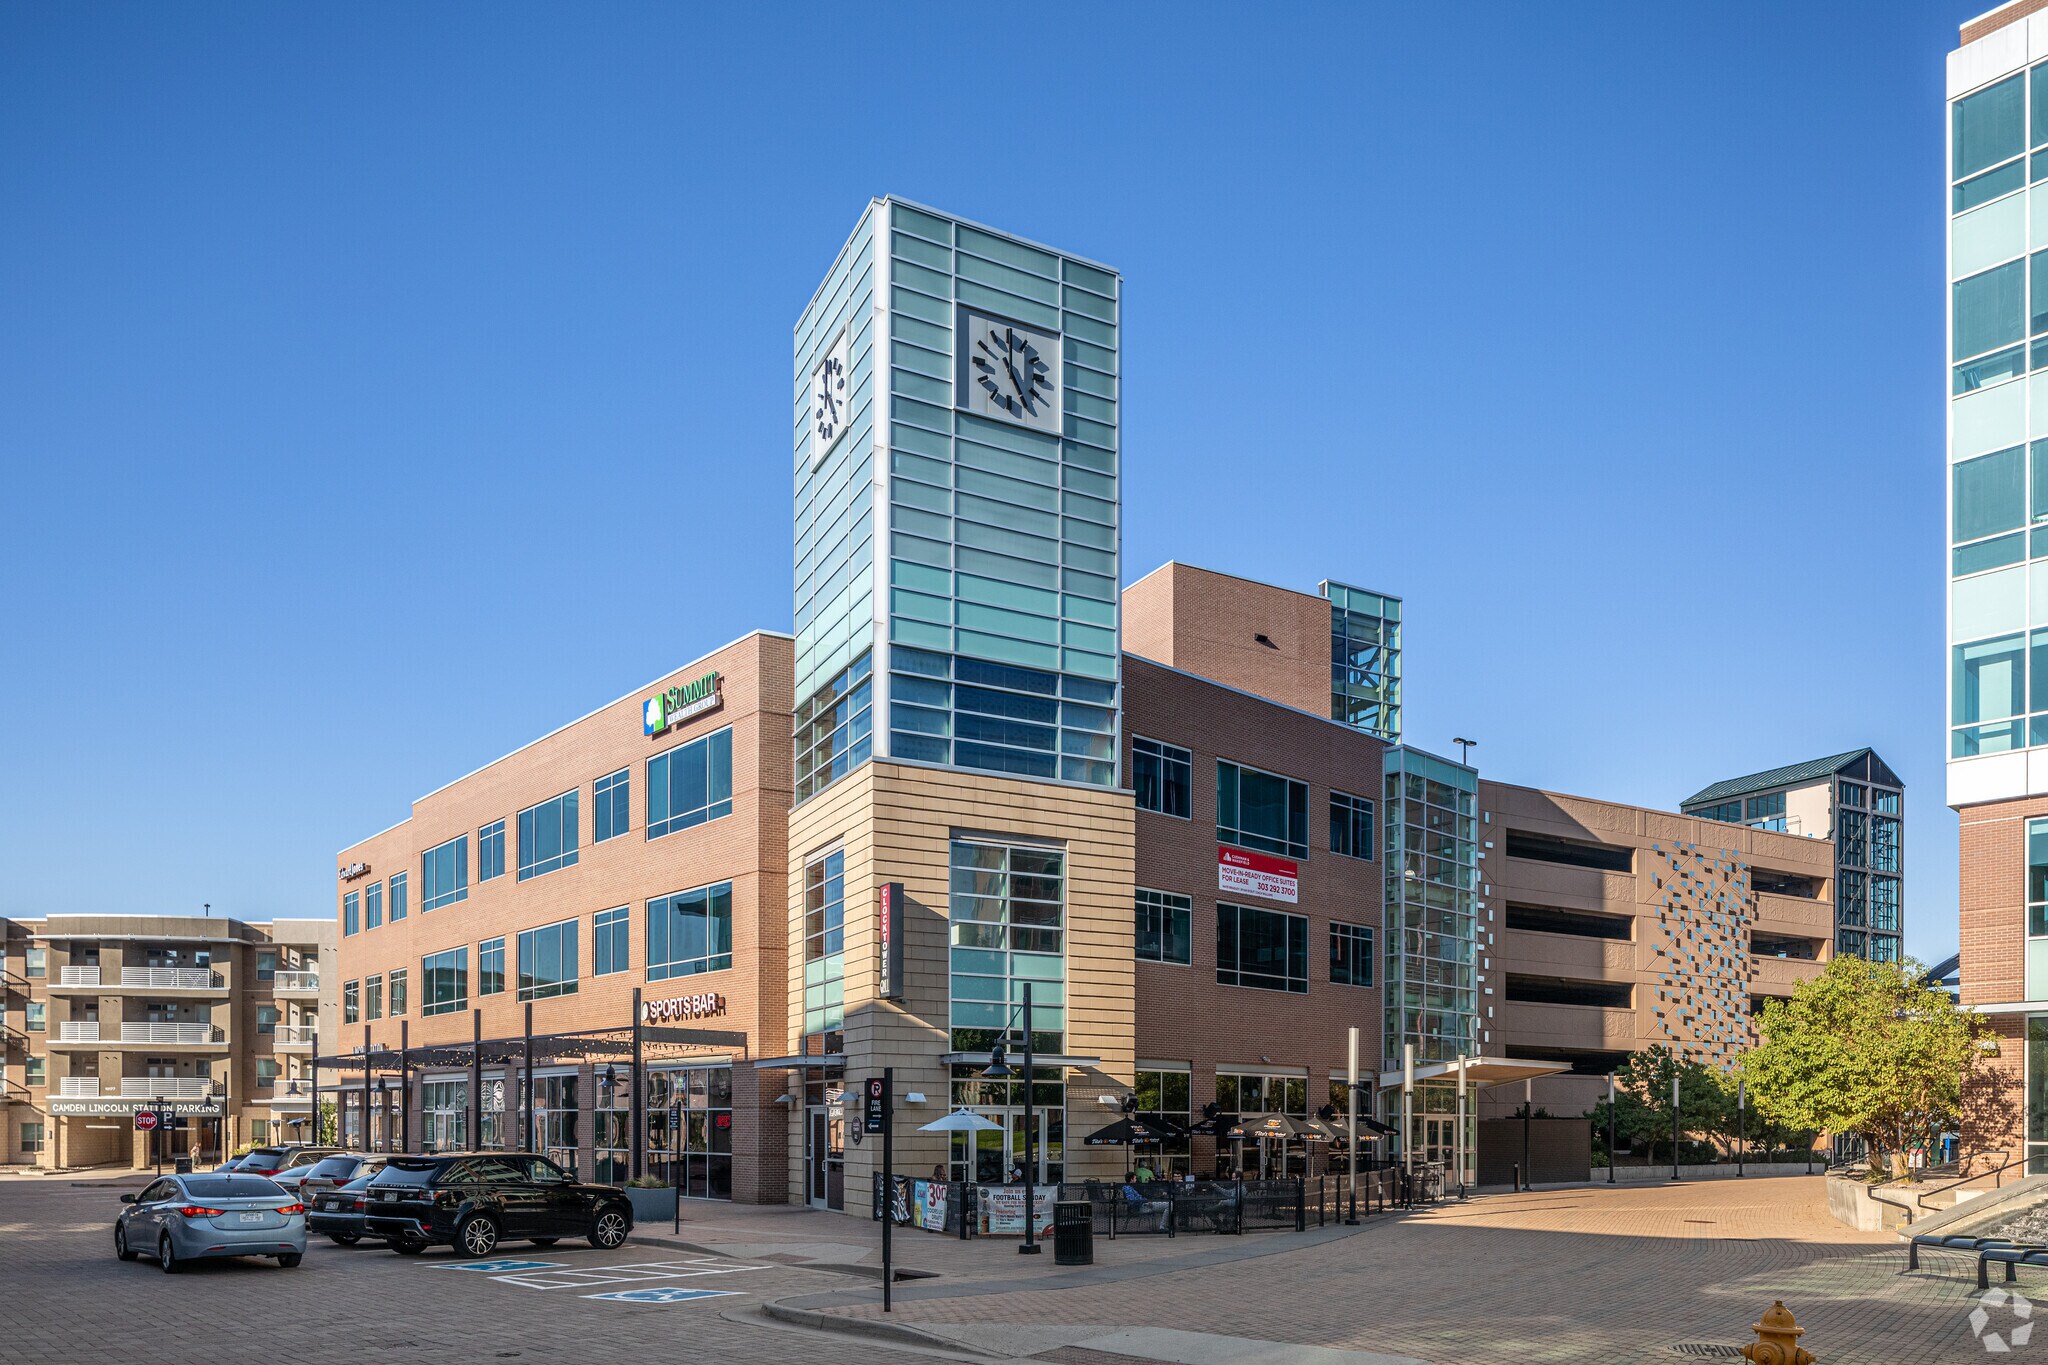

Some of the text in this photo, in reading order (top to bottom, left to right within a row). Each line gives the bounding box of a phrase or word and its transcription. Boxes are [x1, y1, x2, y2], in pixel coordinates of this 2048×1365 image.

[667, 671, 716, 713] SUMMIT
[1221, 866, 1296, 887] MOVE-IN-READY OFFICE SUITES
[1221, 874, 1249, 886] FOR LEASE
[1257, 882, 1269, 892] 303
[1269, 884, 1281, 894] 292
[1281, 886, 1296, 897] 3700
[881, 887, 889, 978] CLOCKTOWER
[649, 992, 716, 1019] SPORTS BAR
[52, 1103, 86, 1113] CAMDEN
[88, 1103, 129, 1113] LINCOLN
[137, 1116, 156, 1125] STOP
[163, 1112, 173, 1122] P
